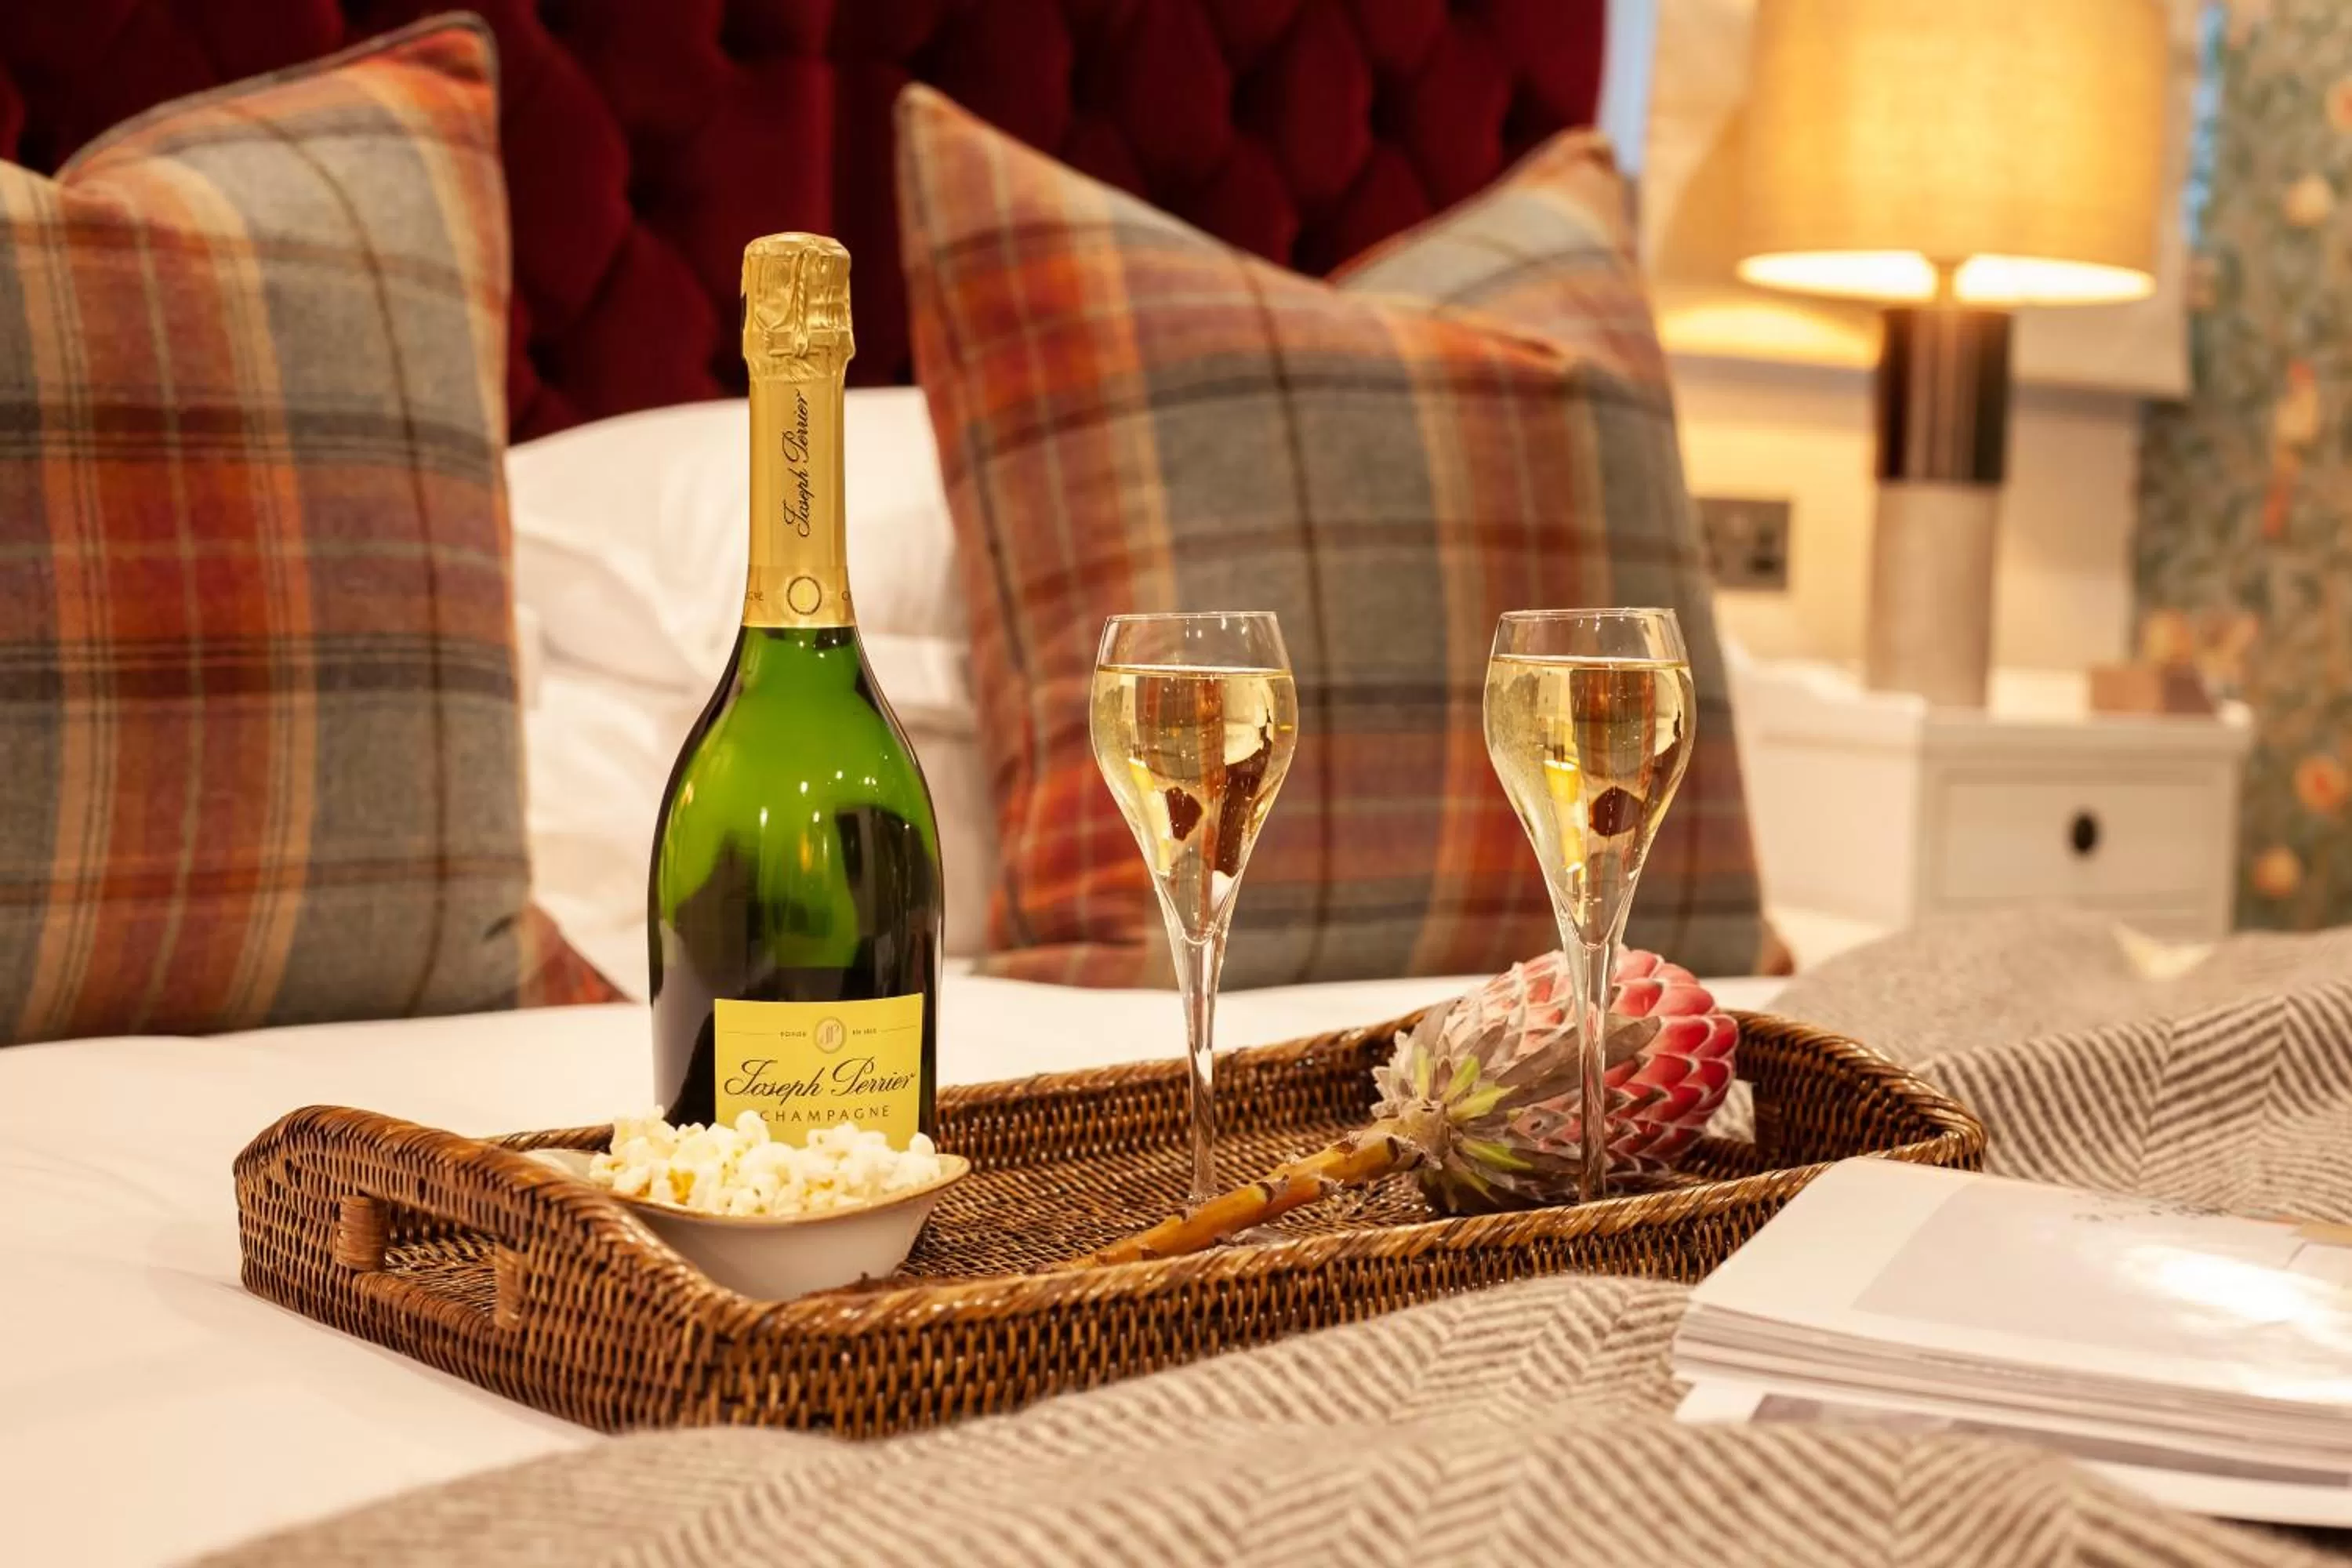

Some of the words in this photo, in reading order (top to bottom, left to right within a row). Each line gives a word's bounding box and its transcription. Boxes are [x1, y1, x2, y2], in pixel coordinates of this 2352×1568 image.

[782, 389, 809, 463] Perrier
[784, 468, 815, 537] Joseph
[724, 1058, 825, 1105] Joseph
[831, 1056, 916, 1096] Perrier
[760, 1105, 890, 1122] CHAMPAGNE
